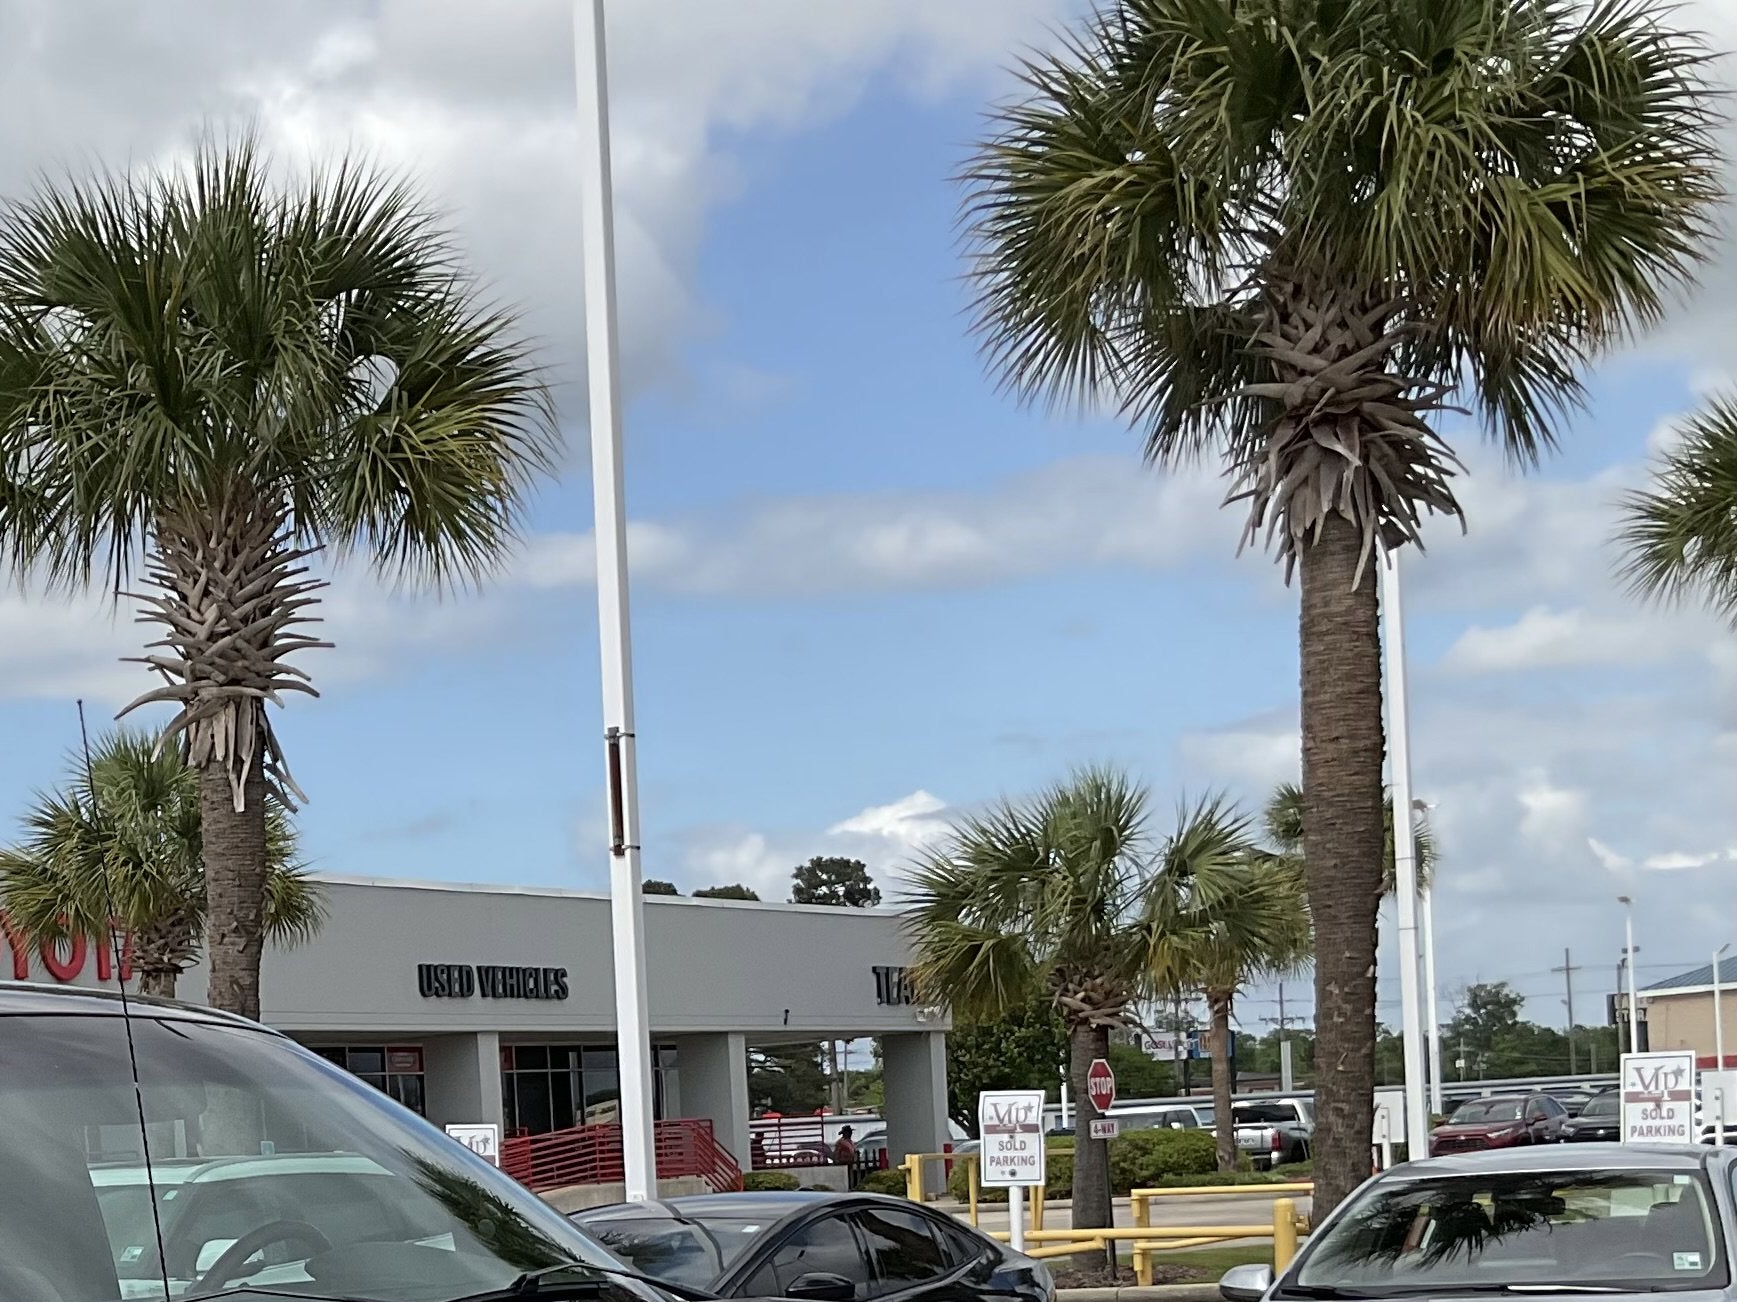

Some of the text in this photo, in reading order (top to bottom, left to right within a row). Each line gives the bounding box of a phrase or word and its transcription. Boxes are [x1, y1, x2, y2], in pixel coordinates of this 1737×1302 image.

[417, 963, 569, 1001] USED VEHICLES
[1090, 1077, 1112, 1096] STOP
[1641, 1107, 1675, 1121] SOLD
[1093, 1122, 1115, 1136] 4-WAY
[1630, 1124, 1686, 1138] PARKING
[998, 1140, 1027, 1152] SOLD
[989, 1155, 1036, 1167] PARKING
